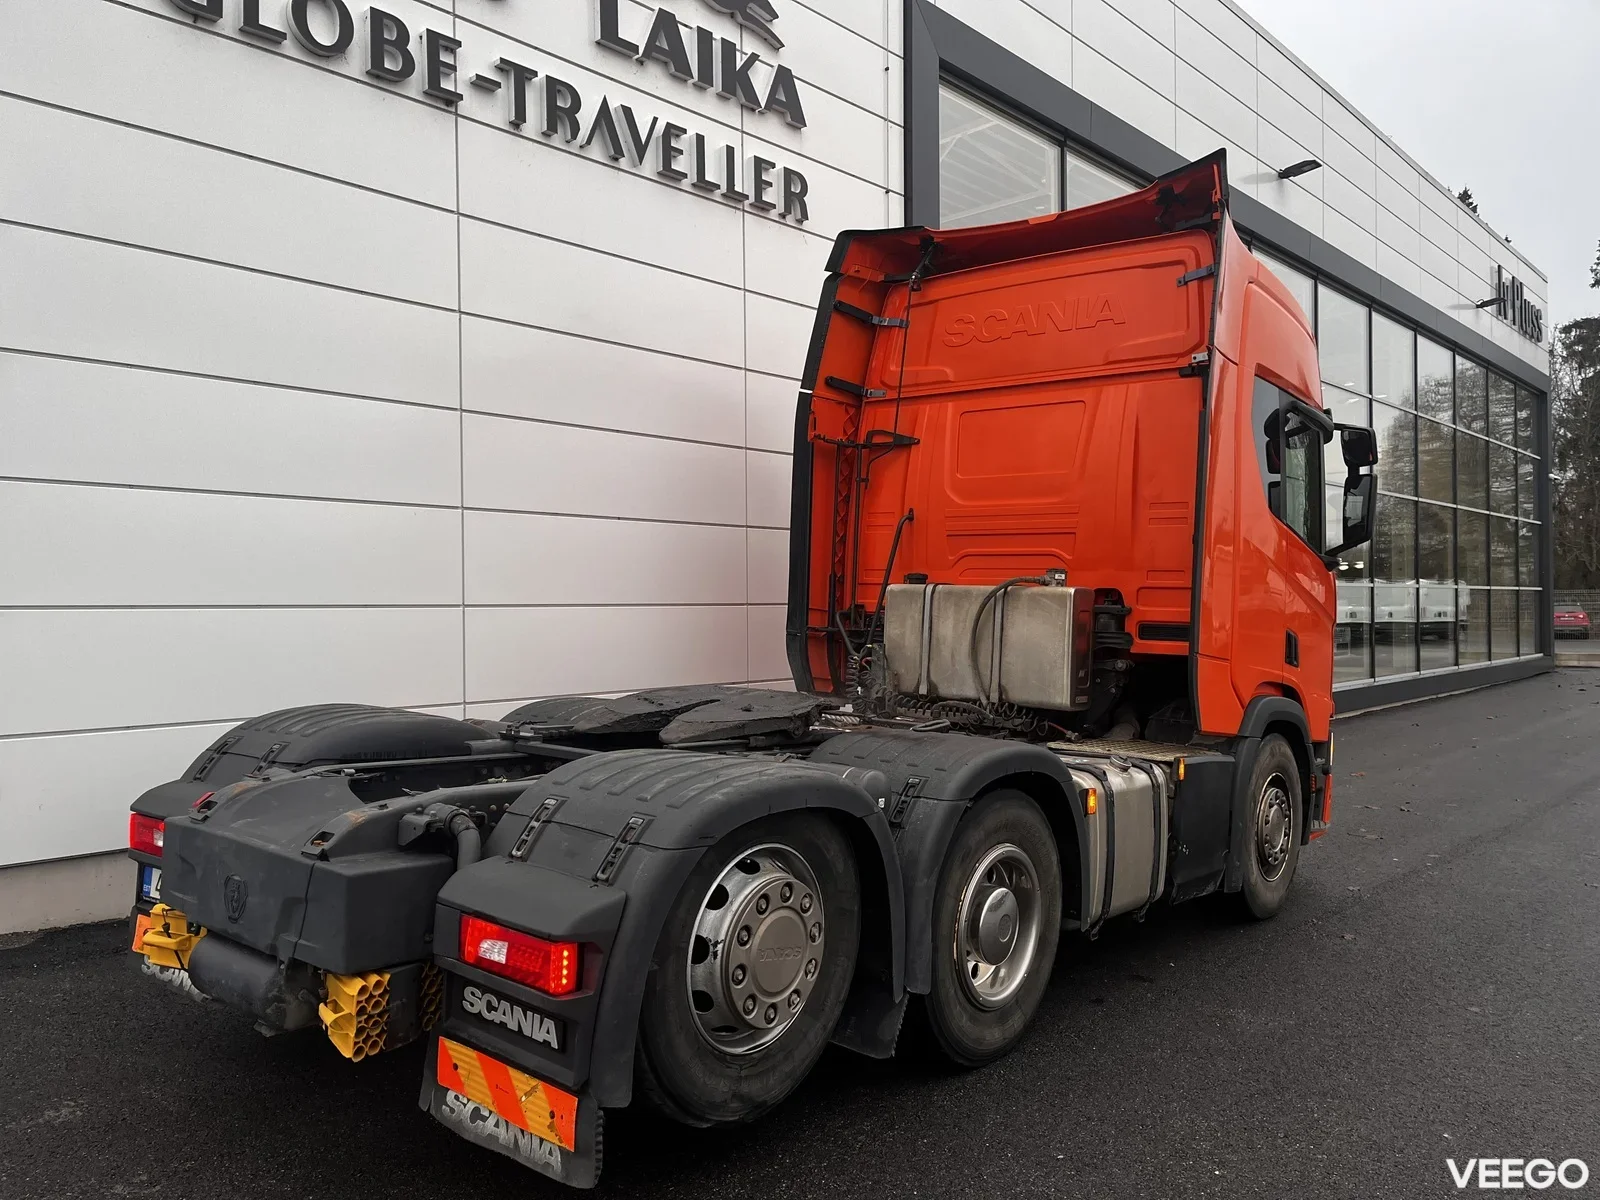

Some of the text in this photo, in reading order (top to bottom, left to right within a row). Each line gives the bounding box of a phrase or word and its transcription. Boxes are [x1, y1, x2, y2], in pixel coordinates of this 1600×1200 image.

[596, 0, 807, 130] LAIKA
[168, 0, 810, 223] LOBE-TRAVELLER
[943, 293, 1126, 348] SCANIA
[462, 986, 559, 1050] SCANIA
[442, 1089, 562, 1174] SCANIA
